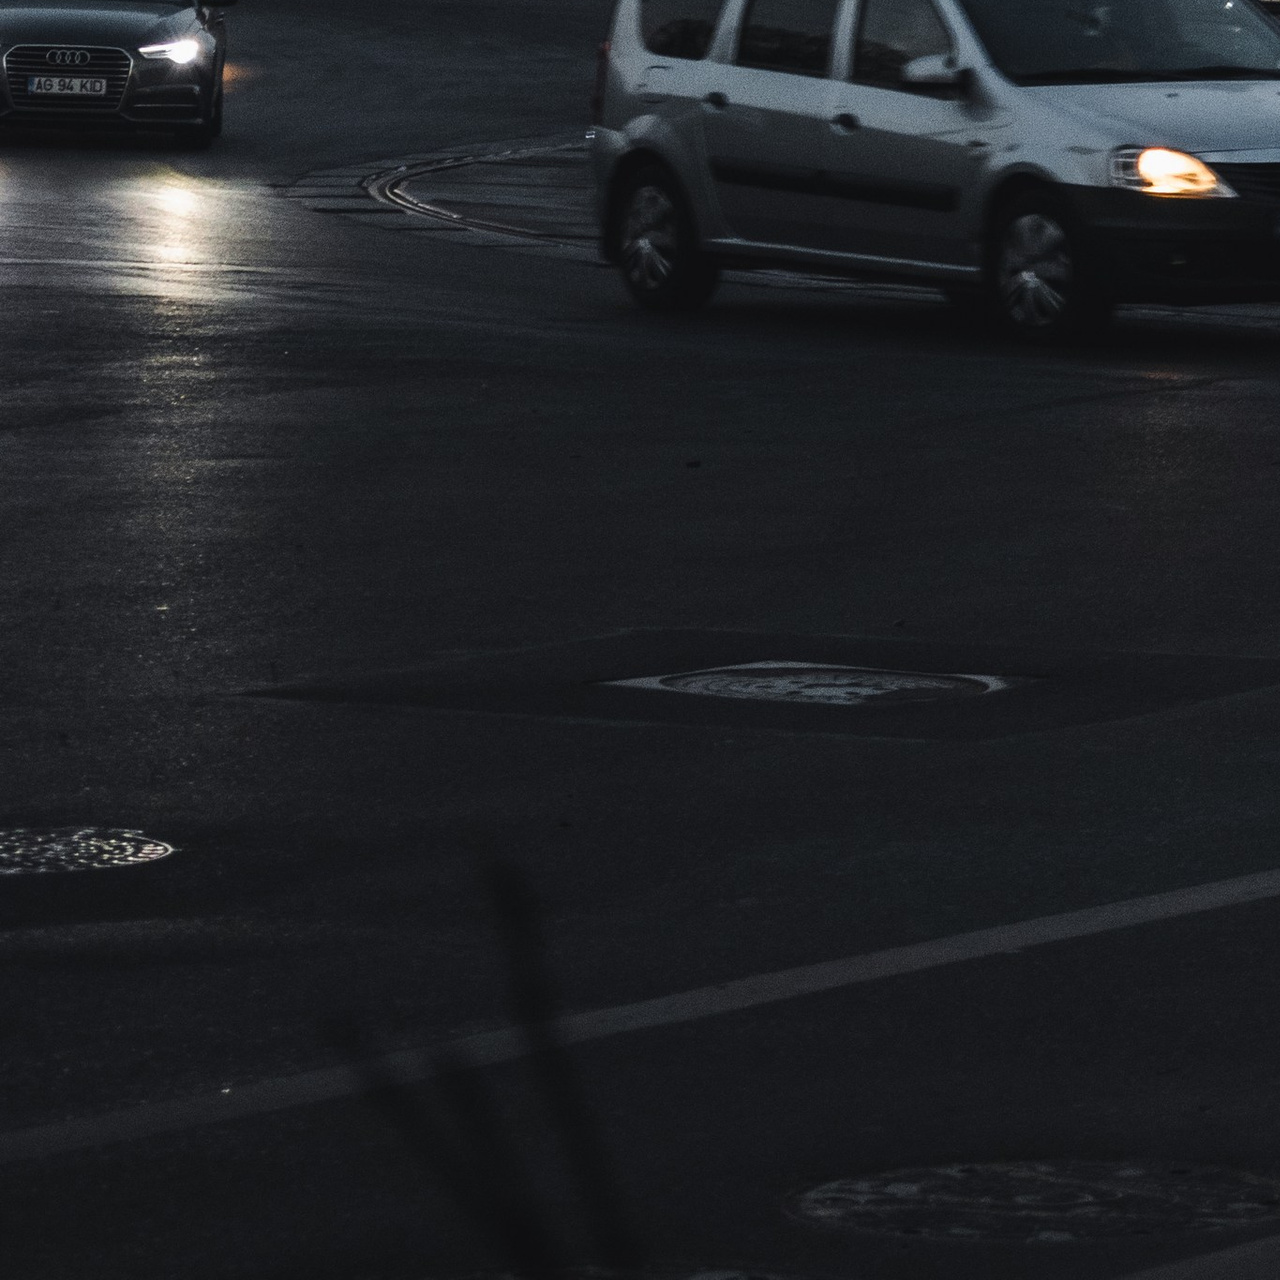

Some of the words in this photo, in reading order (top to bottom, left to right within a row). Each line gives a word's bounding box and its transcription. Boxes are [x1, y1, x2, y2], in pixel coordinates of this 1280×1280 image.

[36, 78, 53, 92] AG
[58, 78, 75, 92] 94
[80, 79, 103, 93] KID
